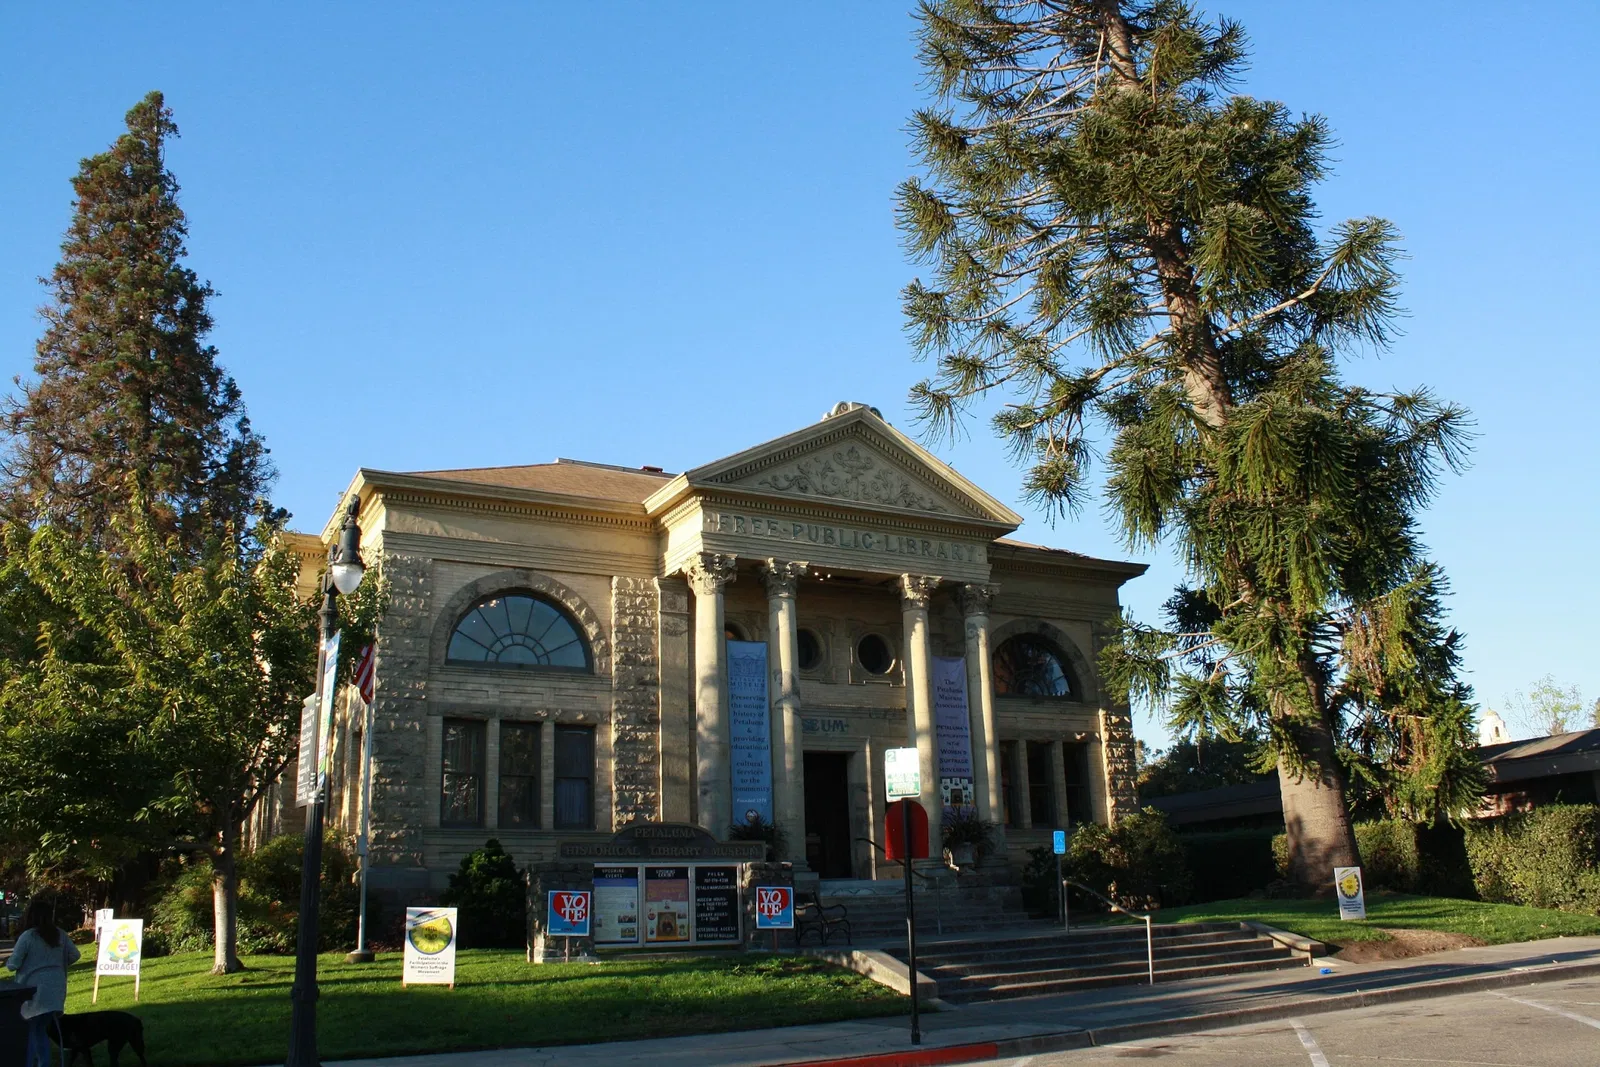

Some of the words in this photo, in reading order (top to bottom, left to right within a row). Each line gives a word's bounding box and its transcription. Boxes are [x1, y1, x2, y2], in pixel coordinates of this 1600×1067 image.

[717, 514, 779, 537] FREE
[791, 523, 873, 550] PUBLIC
[884, 534, 975, 561] LIBRARY
[731, 693, 766, 701] Preserving
[733, 735, 765, 743] providing
[634, 827, 696, 838] PETALUMA
[566, 845, 641, 856] HISTORICAL
[651, 846, 701, 857] LIBRARY
[711, 846, 759, 857] MUSEUM
[98, 963, 138, 971] COURAGE!
